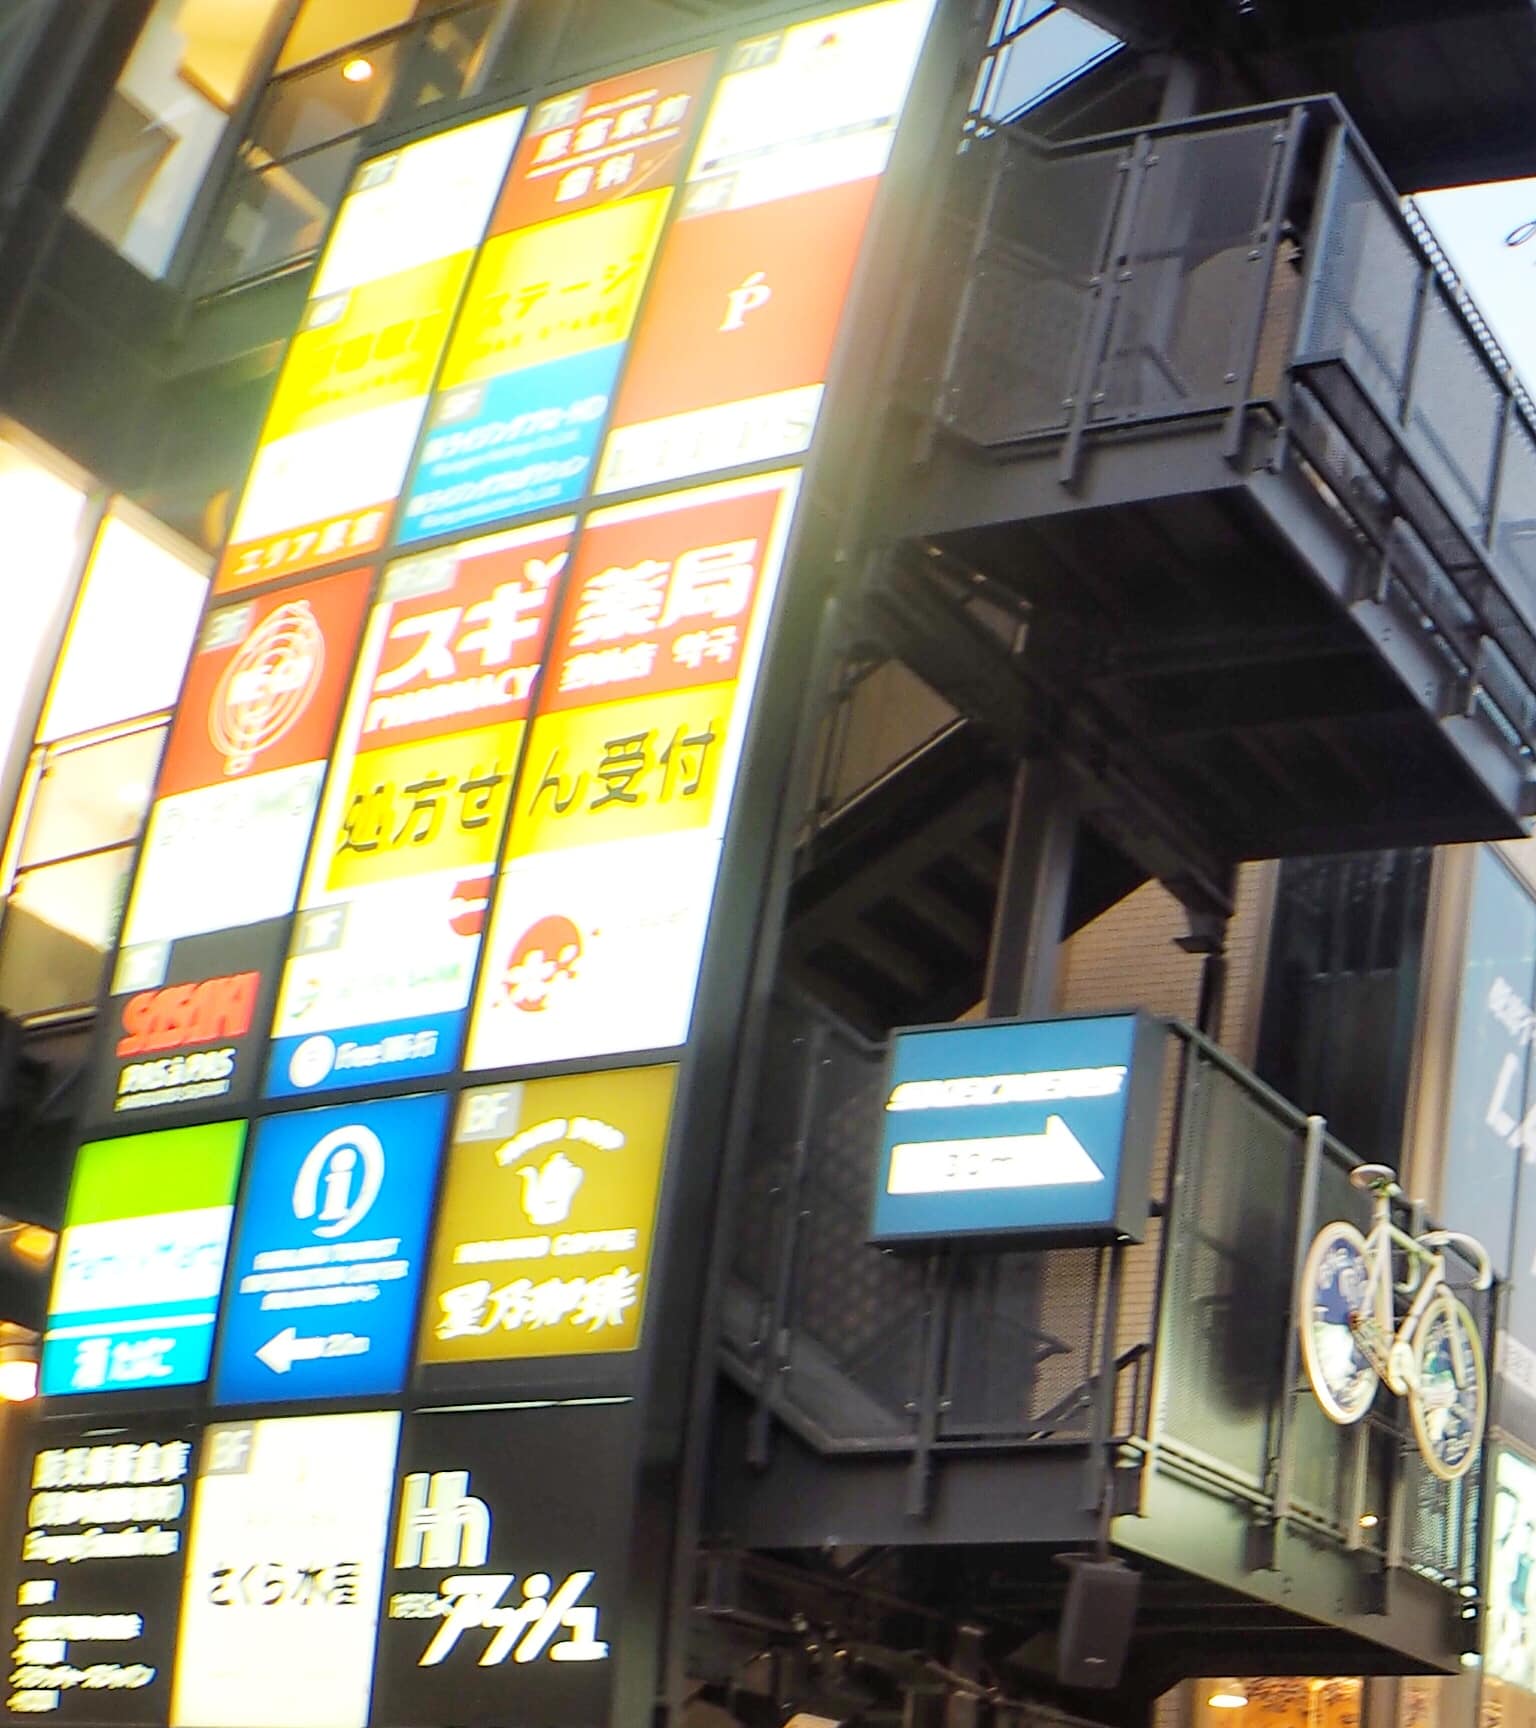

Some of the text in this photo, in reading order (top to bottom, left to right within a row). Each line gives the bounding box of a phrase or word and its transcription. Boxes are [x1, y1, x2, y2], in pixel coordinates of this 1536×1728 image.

[337, 721, 715, 855] 処方せん受付
